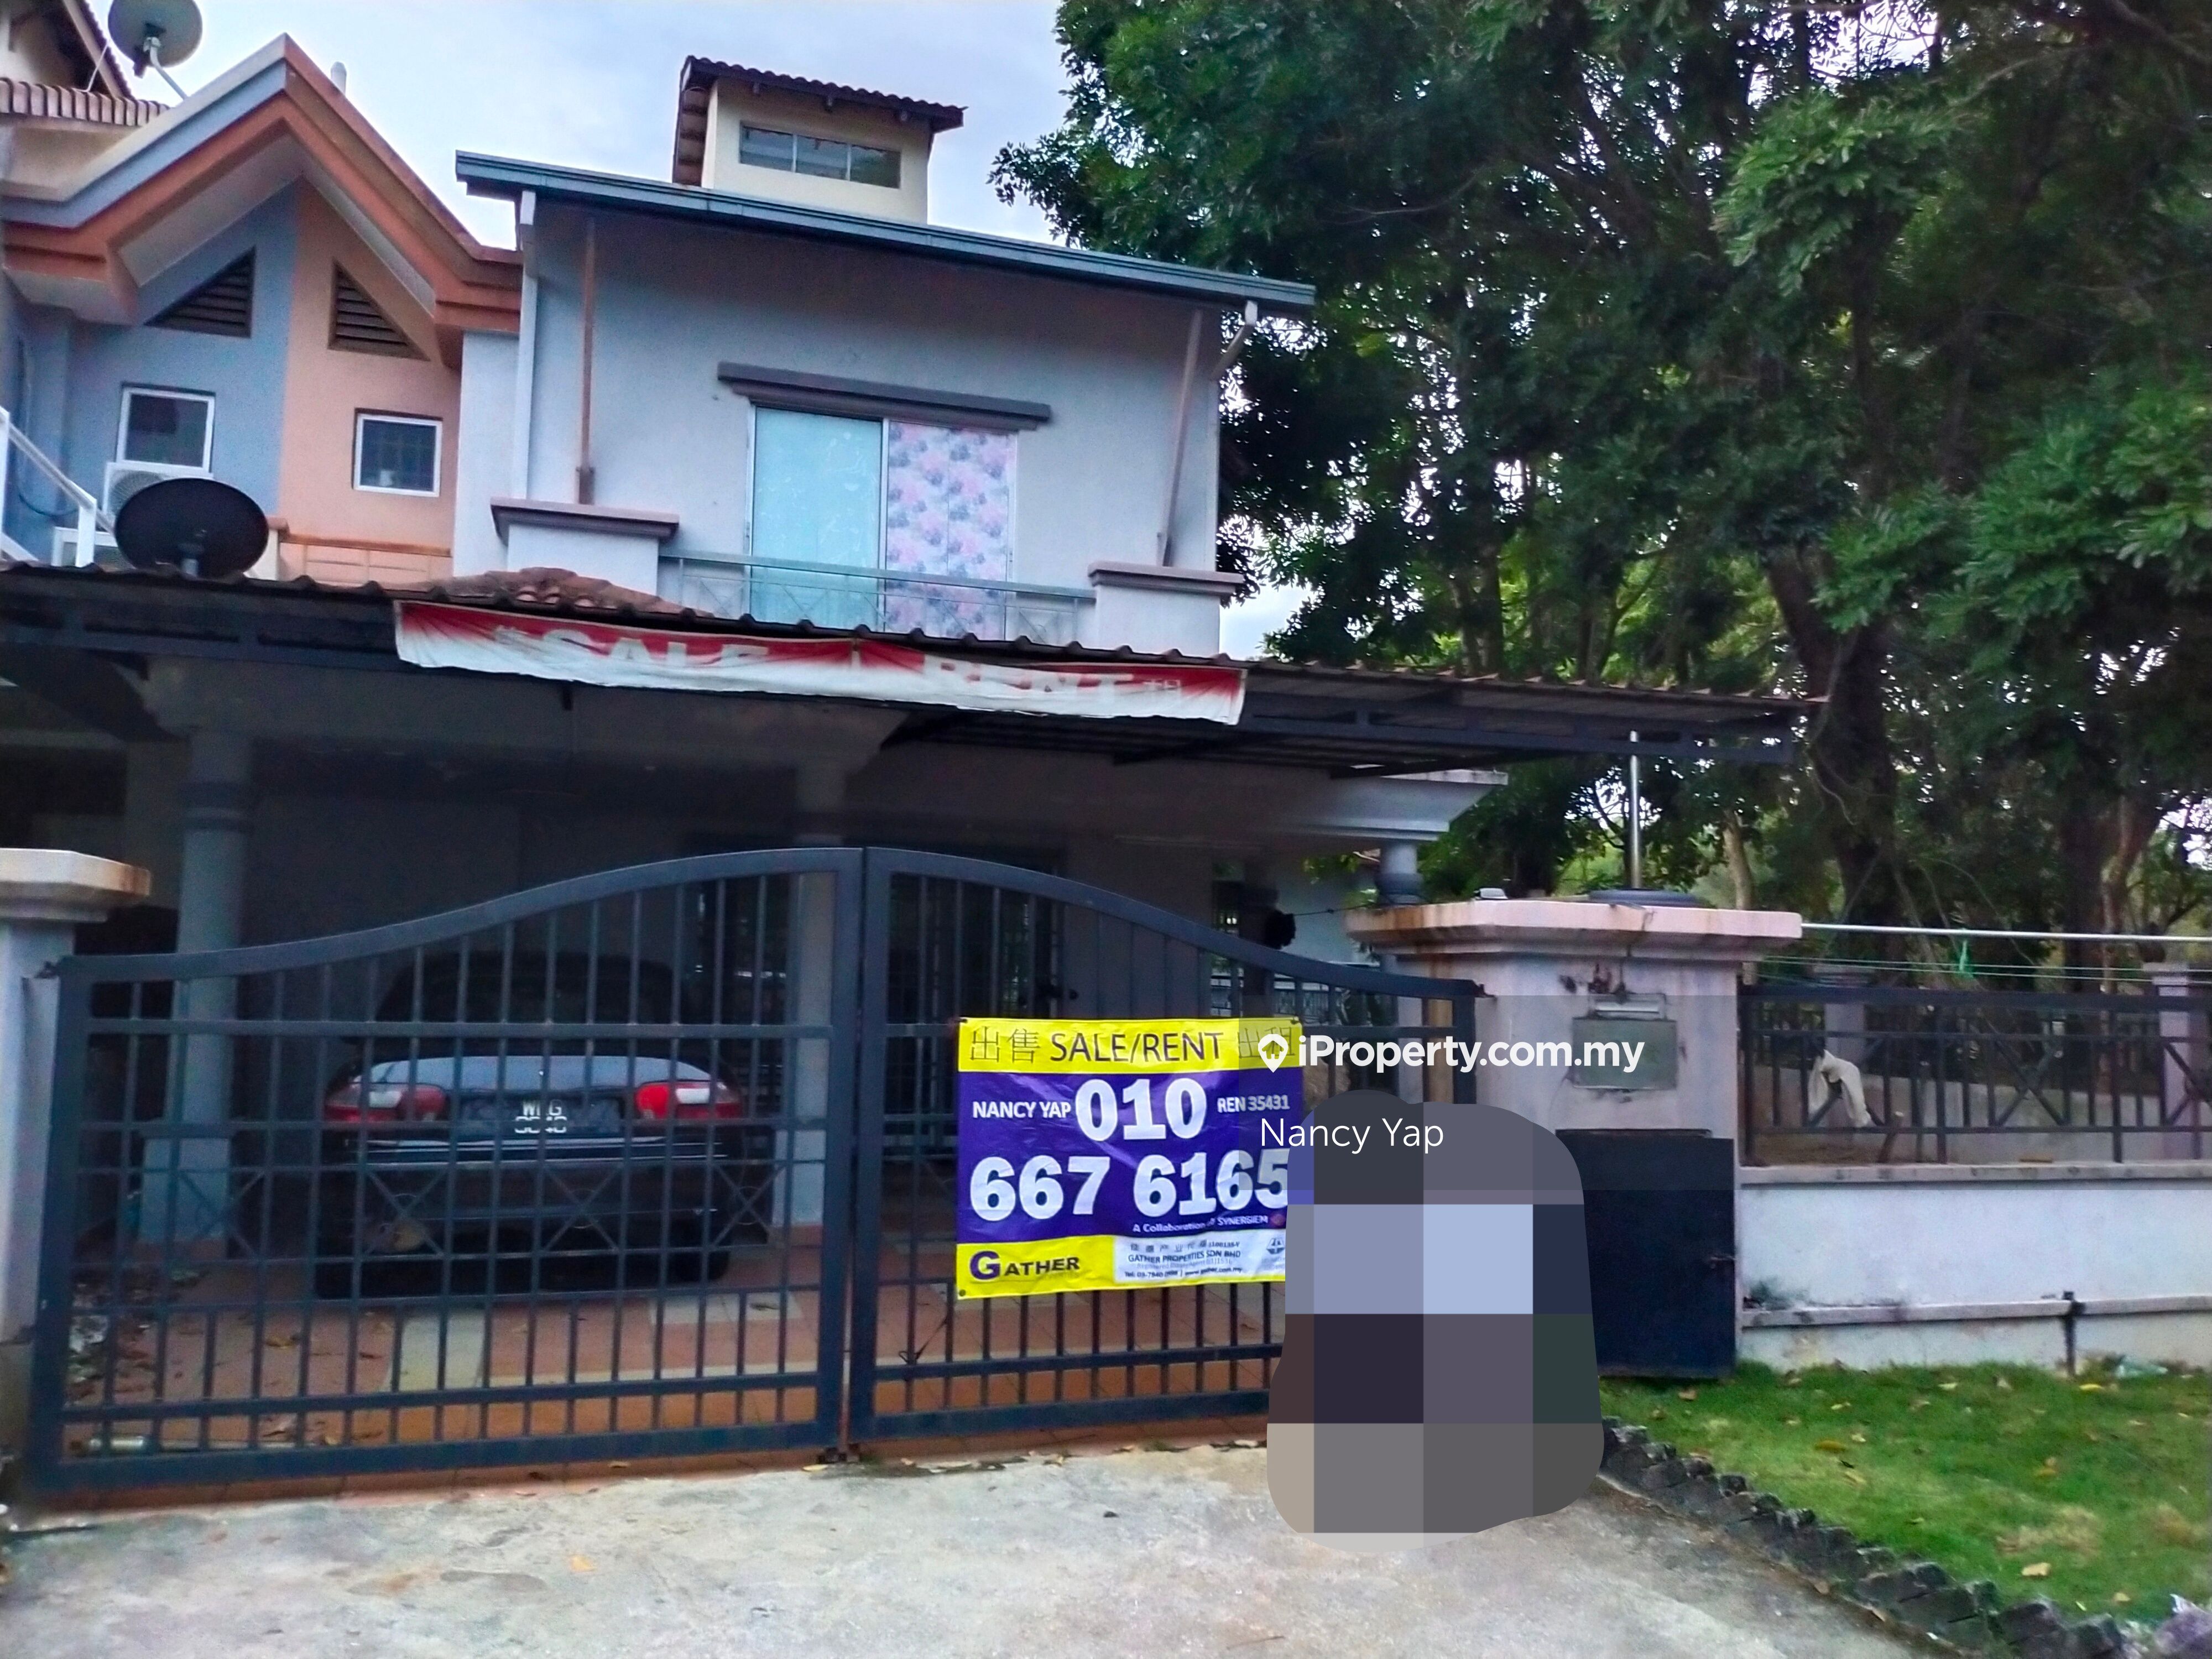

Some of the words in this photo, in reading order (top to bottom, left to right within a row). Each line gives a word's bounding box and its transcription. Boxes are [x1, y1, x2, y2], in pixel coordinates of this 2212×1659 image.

[971, 1026, 1040, 1063] 出售
[1050, 1032, 1224, 1063] SALE/RENT
[973, 1101, 1037, 1118] NANCY
[1039, 1101, 1072, 1118] YAP
[1075, 1078, 1207, 1141] 010
[1217, 1097, 1246, 1113] REN
[1248, 1094, 1290, 1112] 35431
[970, 1155, 1110, 1221] 667
[1134, 1147, 1289, 1218] 6165
[1133, 1224, 1141, 1233] A
[969, 1250, 1080, 1280] GATHER
[1128, 1254, 1160, 1263] GATHER
